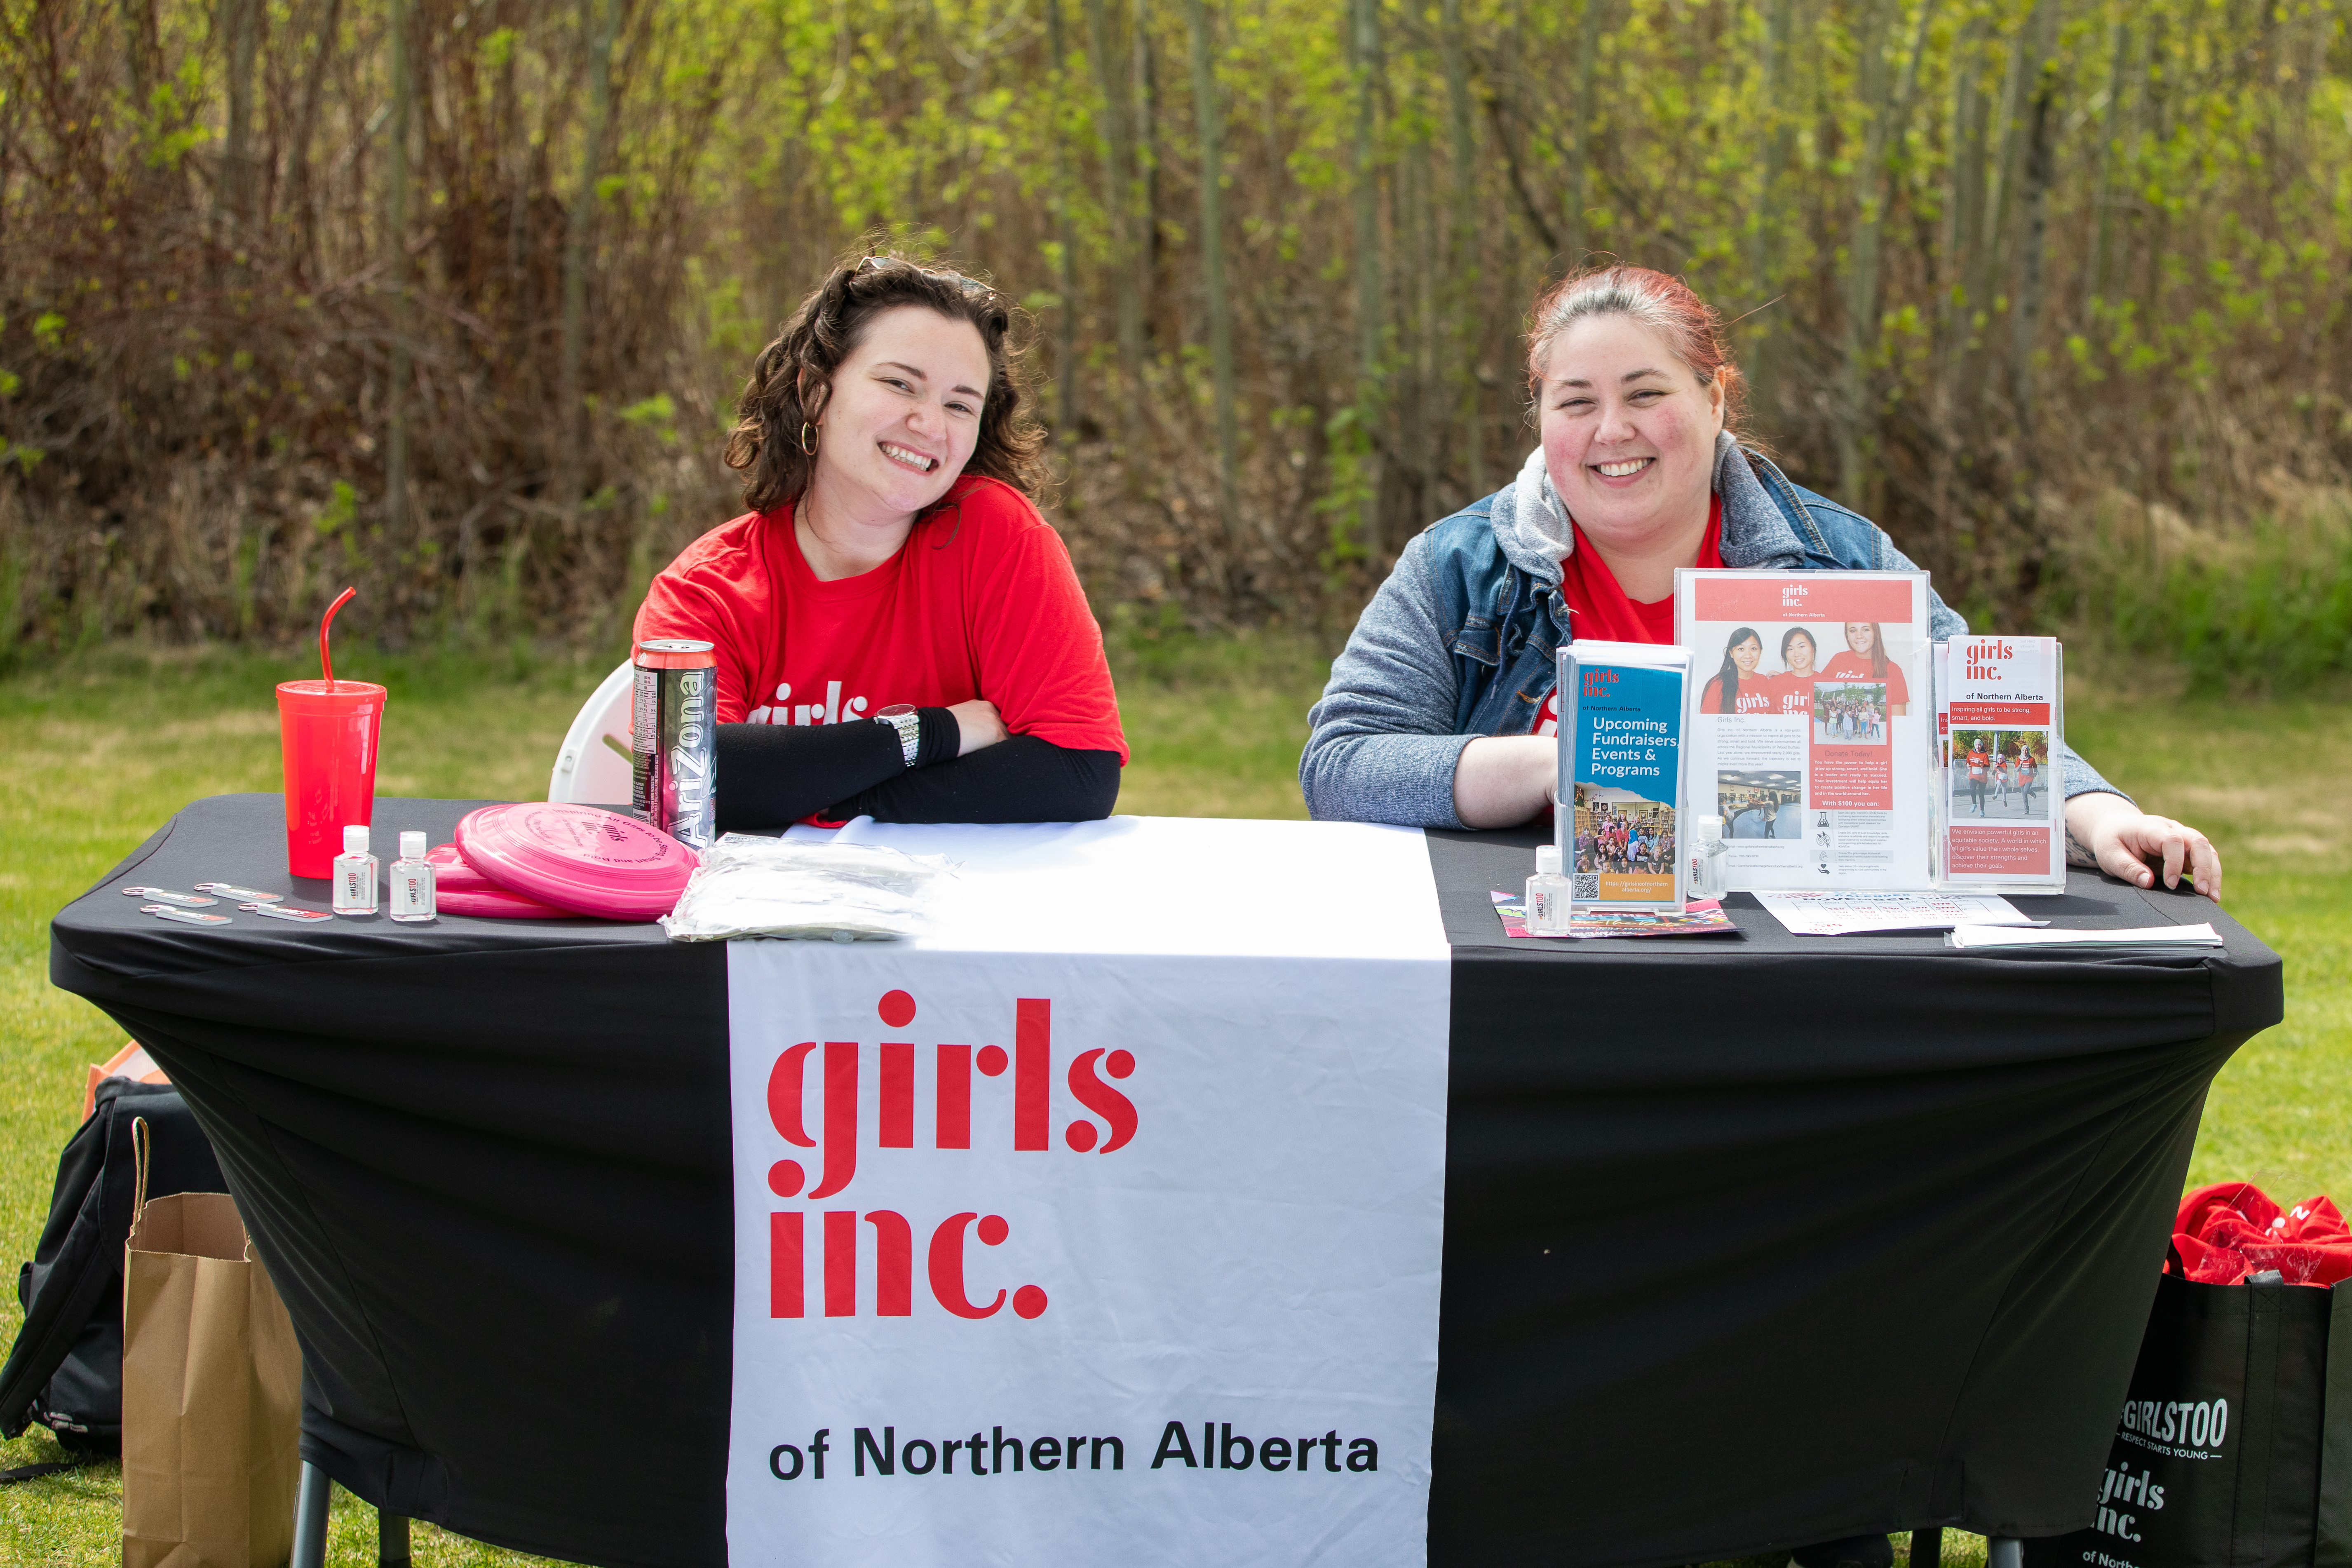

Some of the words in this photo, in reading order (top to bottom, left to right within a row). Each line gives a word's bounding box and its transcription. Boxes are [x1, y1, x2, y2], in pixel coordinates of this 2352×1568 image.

[1782, 584, 1808, 598] girls
[1967, 639, 2012, 665] girls
[1584, 668, 1619, 686] girls
[1967, 666, 2001, 680] inc.
[1583, 687, 1609, 697] inc.
[1736, 693, 1770, 714] girls
[1594, 717, 1667, 734] Upcoming
[1593, 732, 1679, 749] Fundraisers,
[667, 671, 709, 850] AriZona
[1592, 748, 1640, 760] Events
[1645, 749, 1656, 760] &
[1591, 763, 1660, 777] Programs
[552, 809, 601, 818] Inspiring
[603, 825, 628, 842] girls
[623, 822, 646, 832] Girls
[583, 854, 610, 862] Bold
[348, 873, 356, 899] #GIRLSTOO
[408, 878, 416, 905] #GIRLSTOO
[1535, 893, 1544, 920] #GIRLSTOO
[767, 989, 1138, 1199] girls
[770, 1210, 1047, 1319] inc.
[2119, 1399, 2228, 1447] GIRLSTOO
[770, 1429, 829, 1480] of
[854, 1426, 1124, 1476] Northern
[1150, 1421, 1378, 1472] Alberta
[2121, 1432, 2146, 1446] RESPECT
[2147, 1441, 2171, 1455] STARTS
[2173, 1448, 2208, 1460] YOUNG
[2089, 1505, 2141, 1542] nc.
[2083, 1551, 2097, 1563] of
